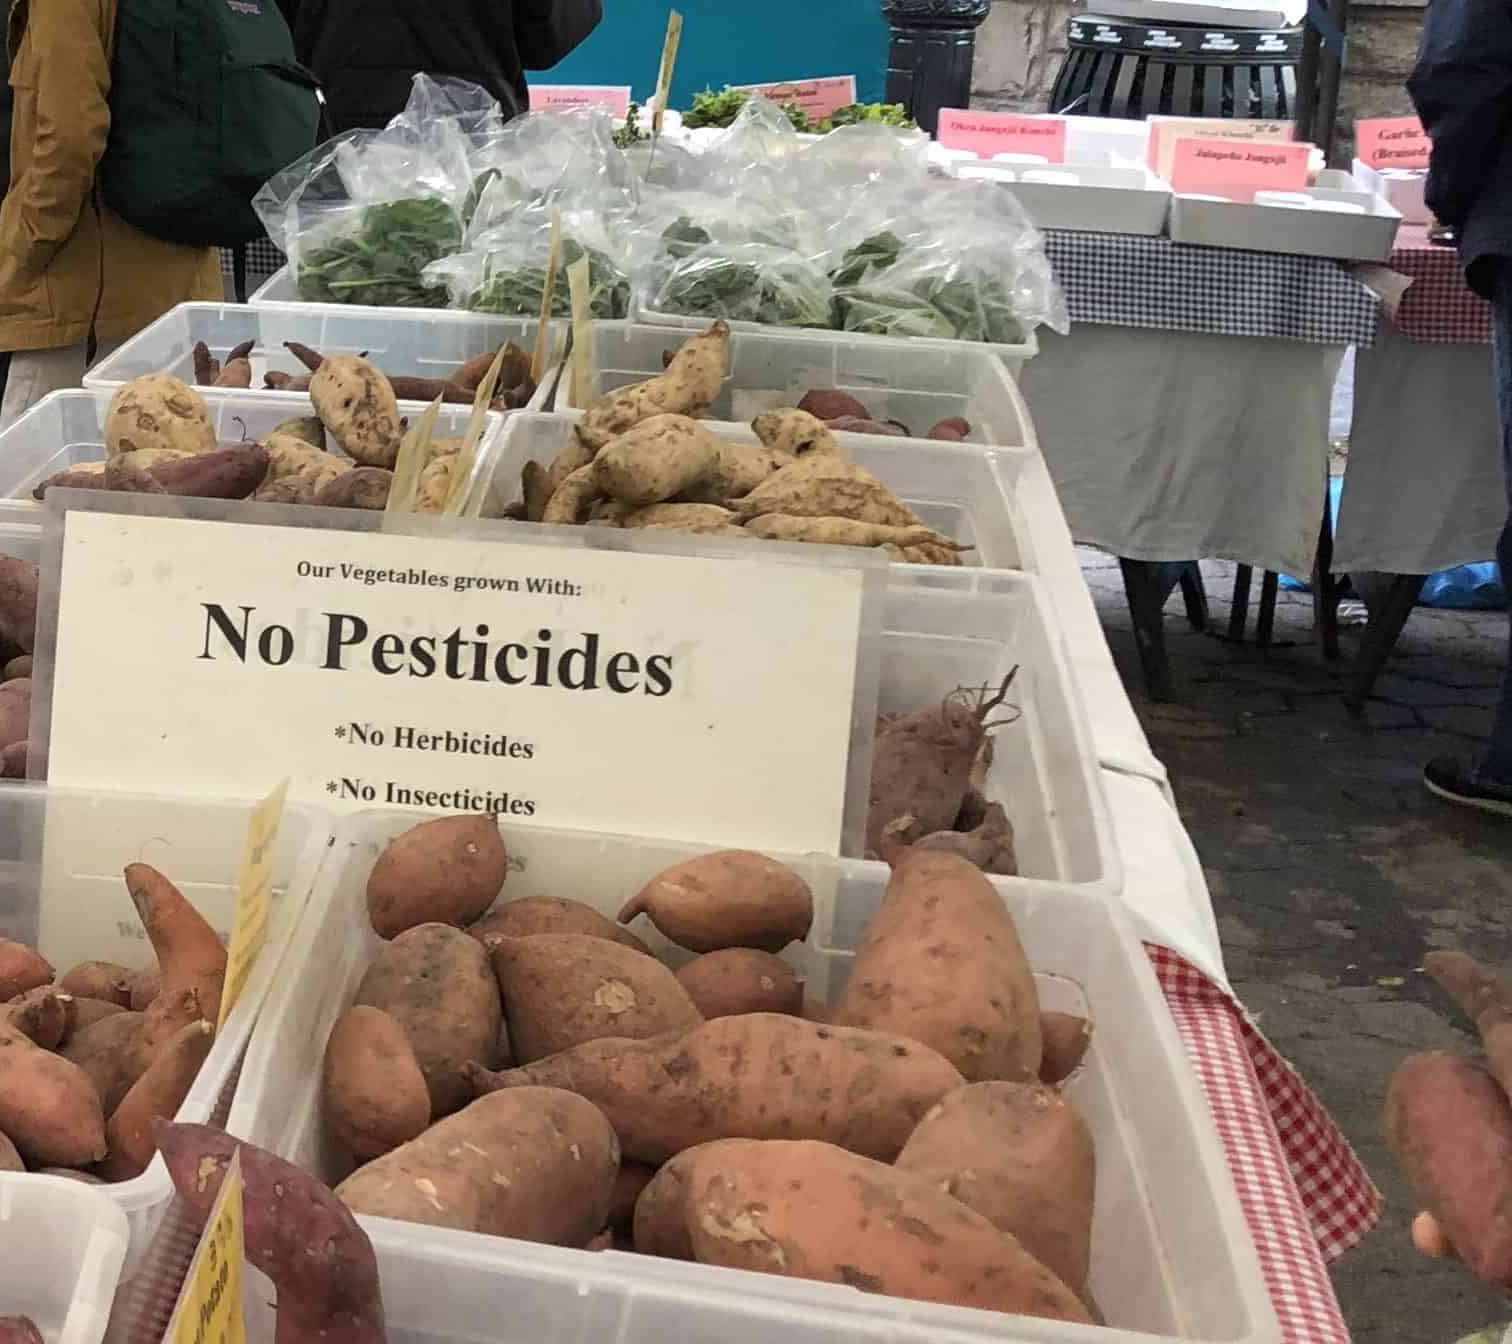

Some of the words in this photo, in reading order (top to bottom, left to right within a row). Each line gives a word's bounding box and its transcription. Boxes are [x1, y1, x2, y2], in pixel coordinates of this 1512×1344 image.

[296, 559, 335, 580] Our
[339, 562, 450, 590] Vegetables
[454, 570, 520, 594] grown
[525, 574, 583, 598] With:
[197, 602, 294, 666] No
[321, 610, 675, 698] Pesticides
[392, 723, 535, 760] Herbicides
[385, 781, 537, 817] Insecticides
